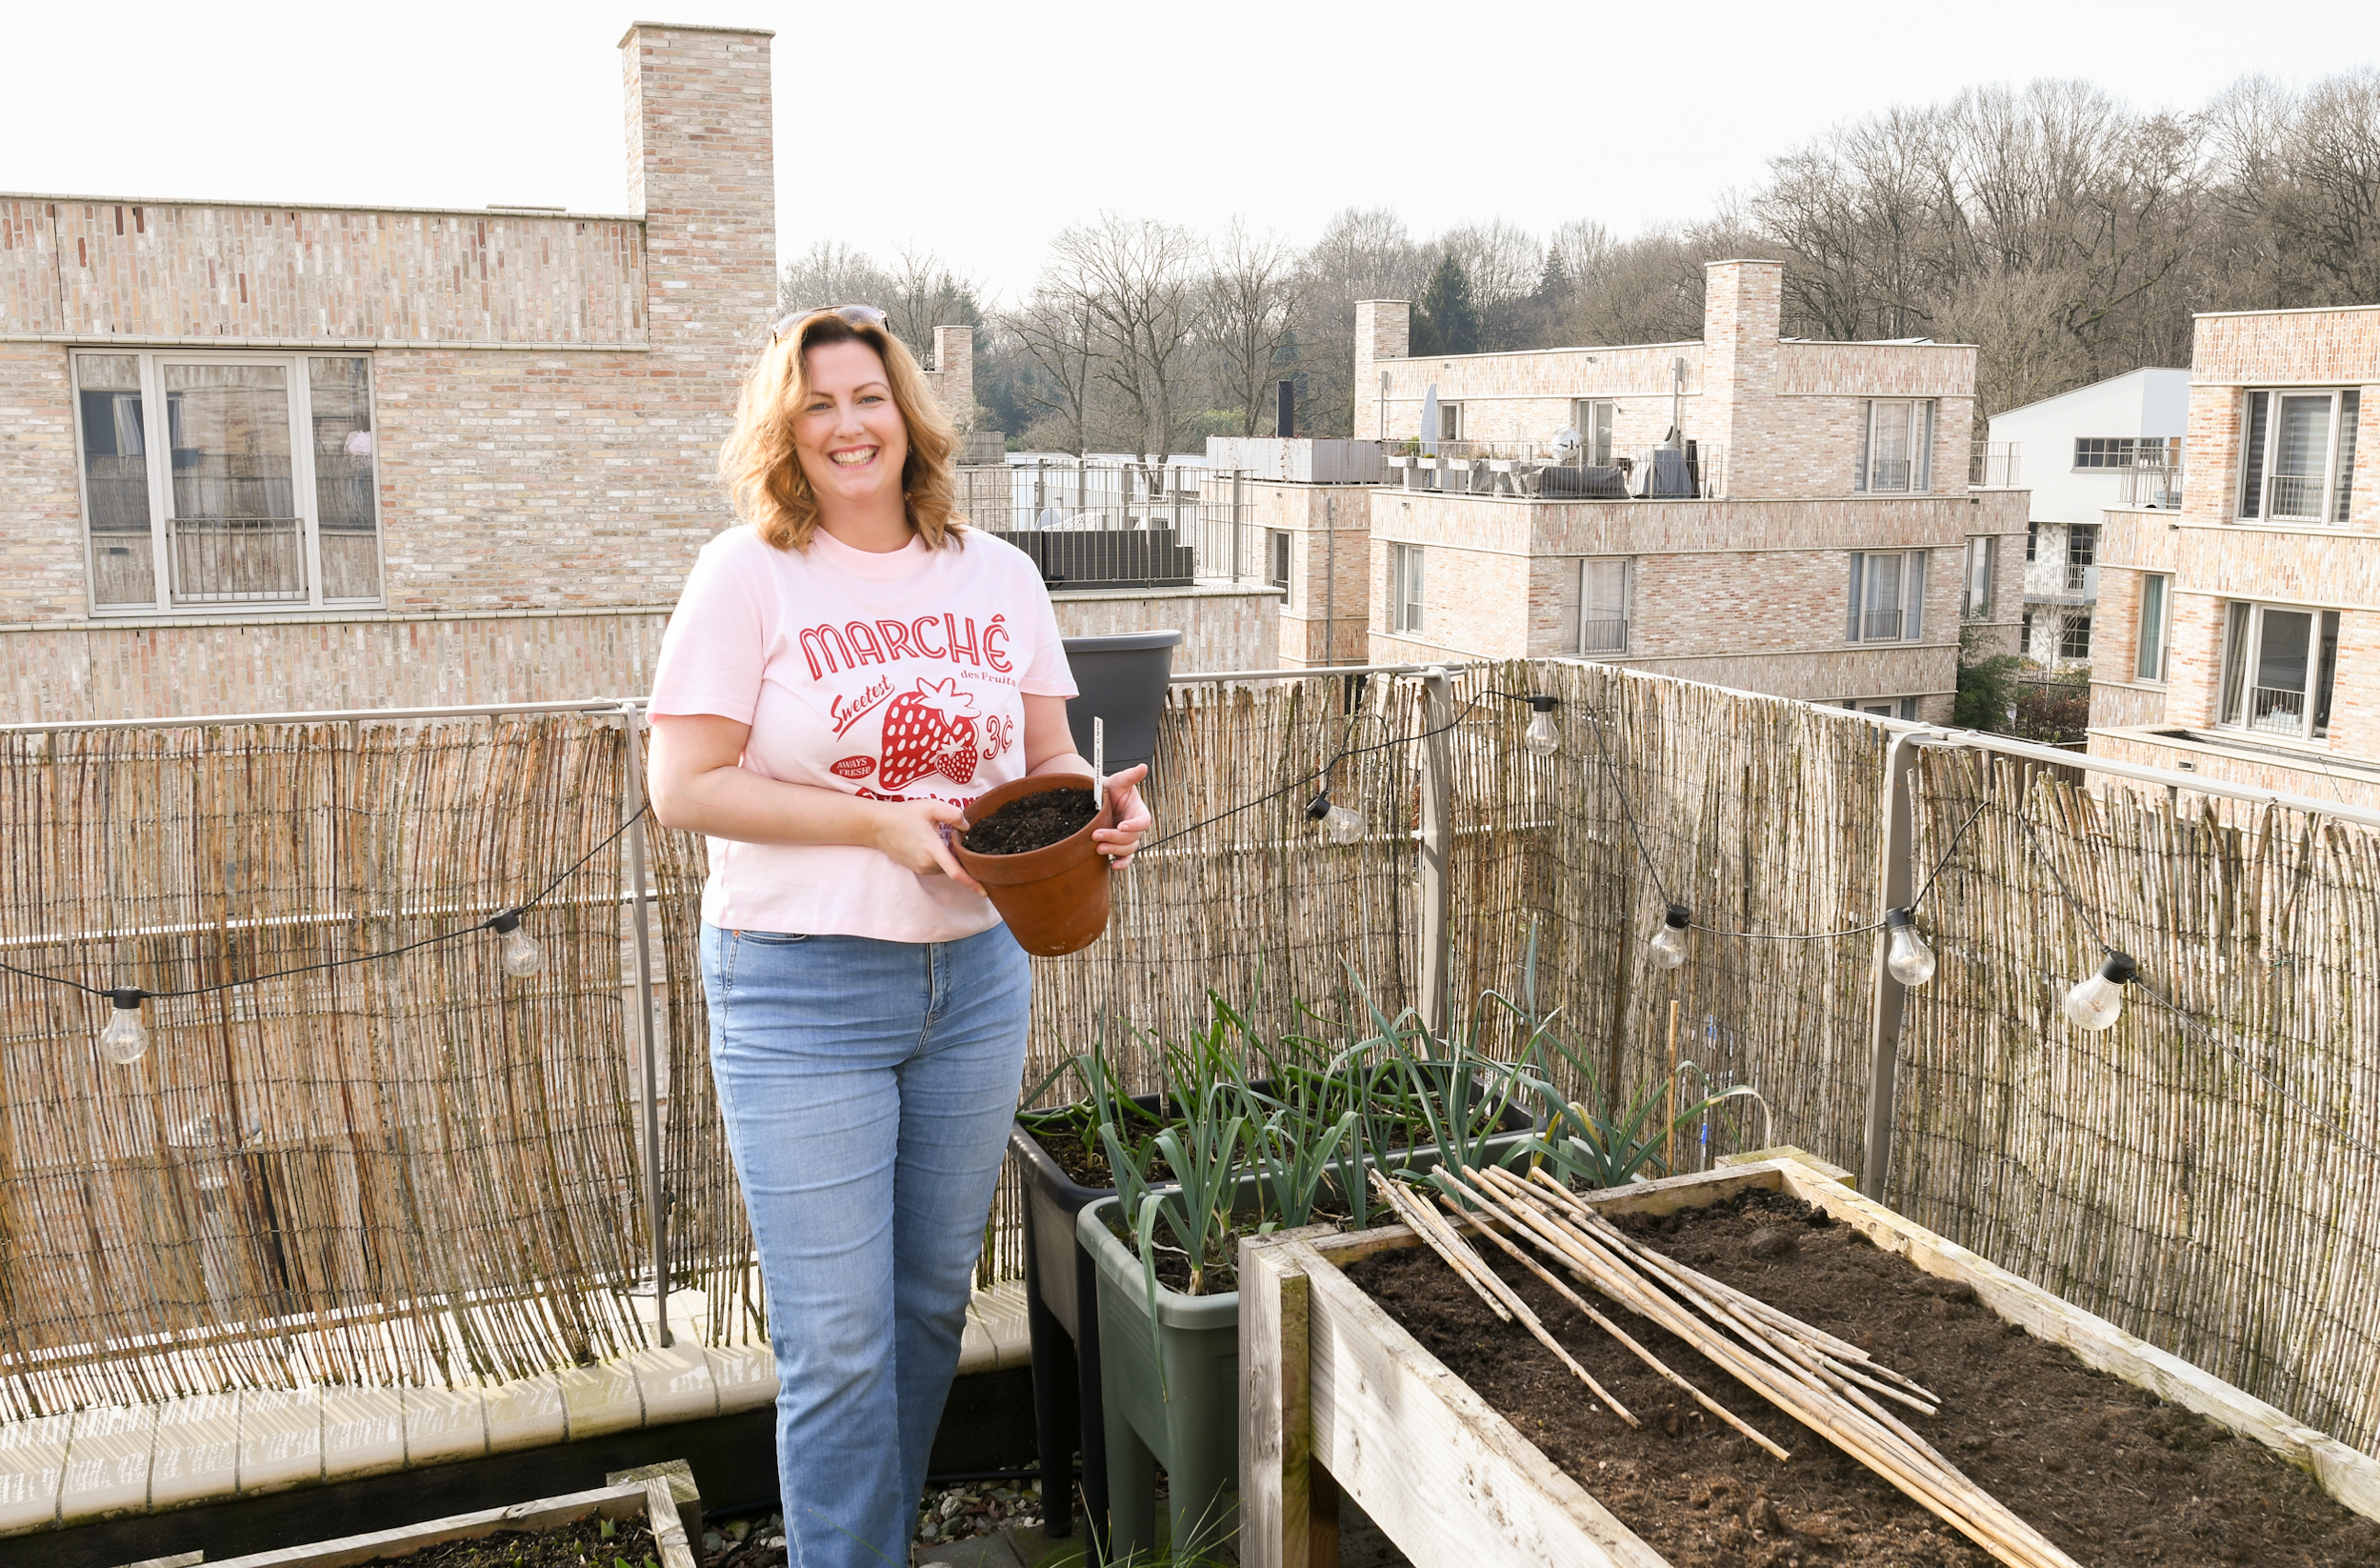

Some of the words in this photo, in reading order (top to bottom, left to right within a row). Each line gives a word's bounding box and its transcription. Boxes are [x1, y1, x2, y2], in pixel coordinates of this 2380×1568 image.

[960, 670, 980, 679] des
[981, 672, 1017, 687] Fruits
[830, 674, 891, 733] Sweetest
[983, 714, 1014, 760] 3¢
[838, 766, 871, 777] FRESH!
